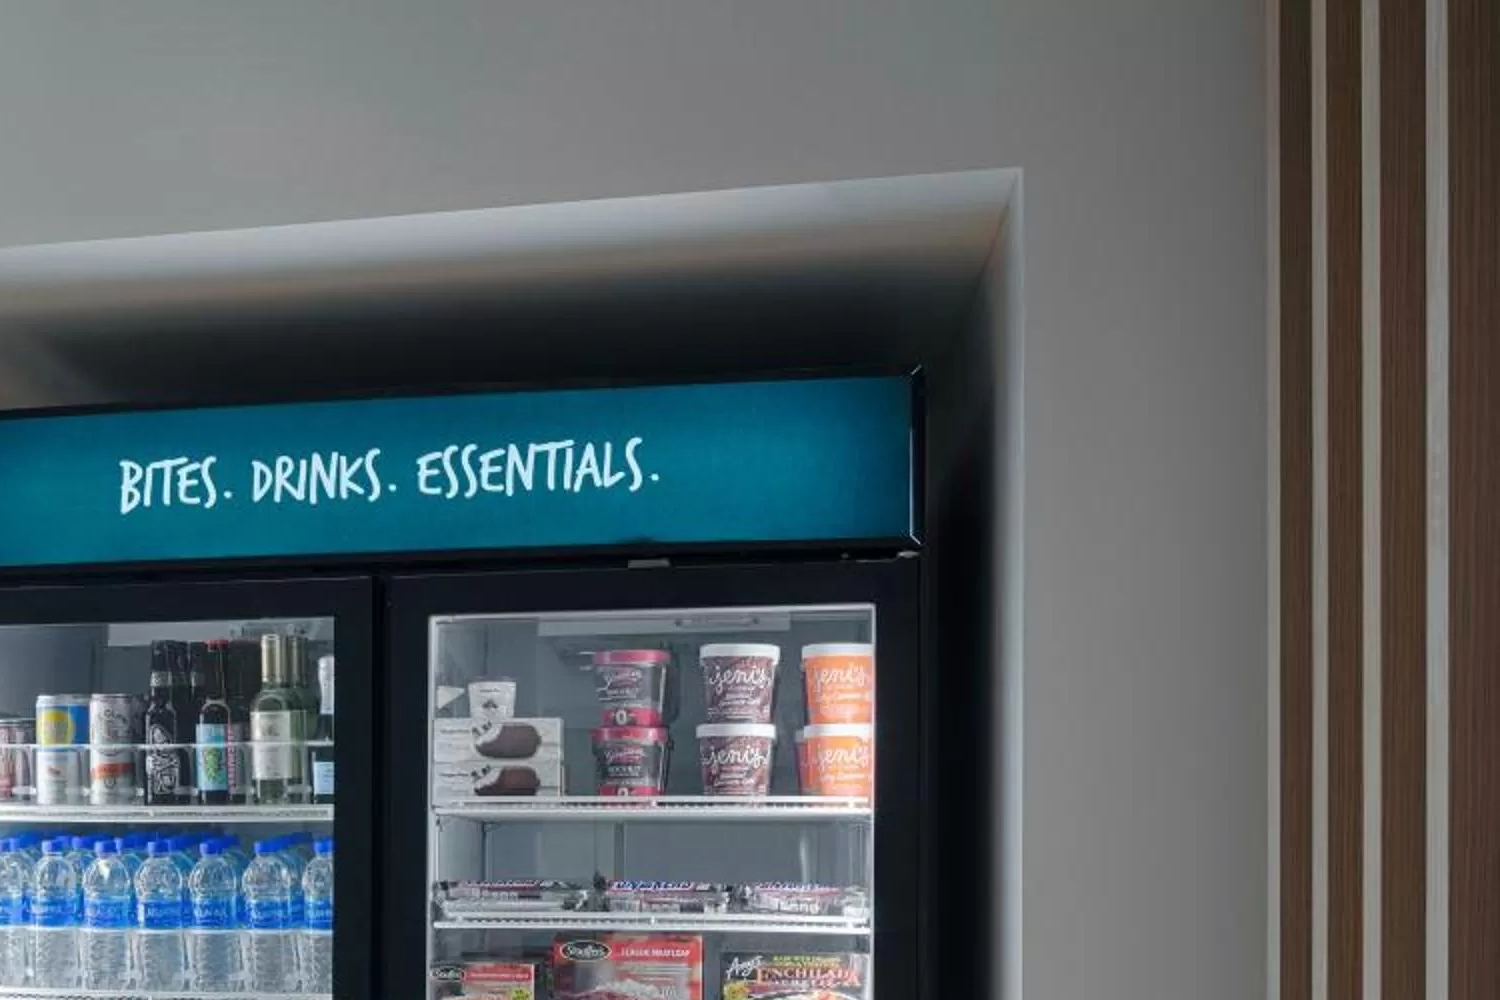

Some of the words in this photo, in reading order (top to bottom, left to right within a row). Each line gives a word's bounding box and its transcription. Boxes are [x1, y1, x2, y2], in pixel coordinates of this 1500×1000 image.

[120, 456, 233, 514] BITES.
[251, 449, 397, 504] DRINKS.
[417, 438, 660, 497] ESSENTIALS.
